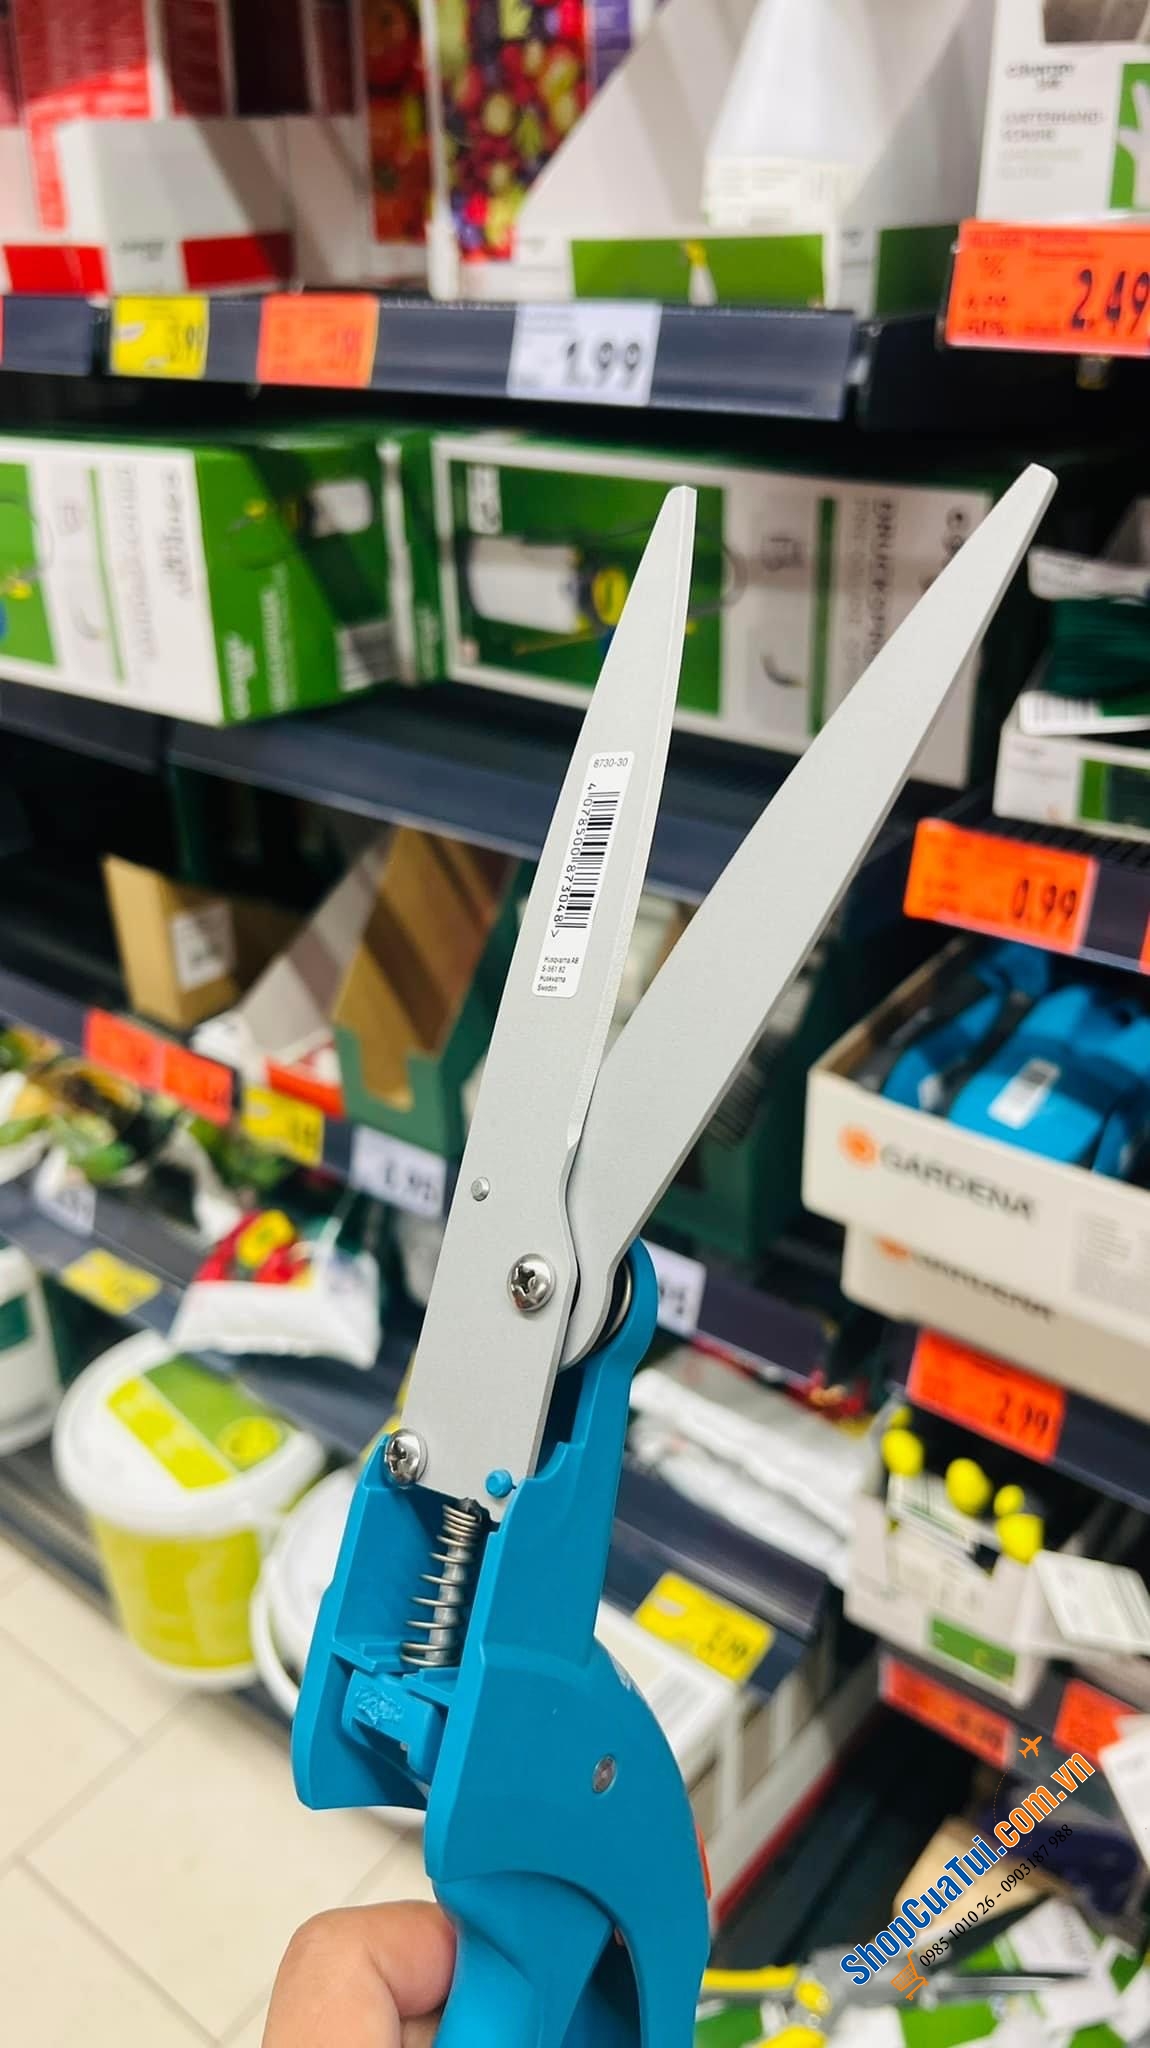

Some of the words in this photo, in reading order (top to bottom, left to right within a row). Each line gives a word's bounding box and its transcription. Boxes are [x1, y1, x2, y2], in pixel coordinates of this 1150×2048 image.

[1071, 268, 1150, 336] 2.49
[564, 341, 641, 391] 1.99
[593, 757, 629, 768] 8730-30
[1011, 879, 1077, 938] 0.99
[880, 1146, 1036, 1222] GARDENA
